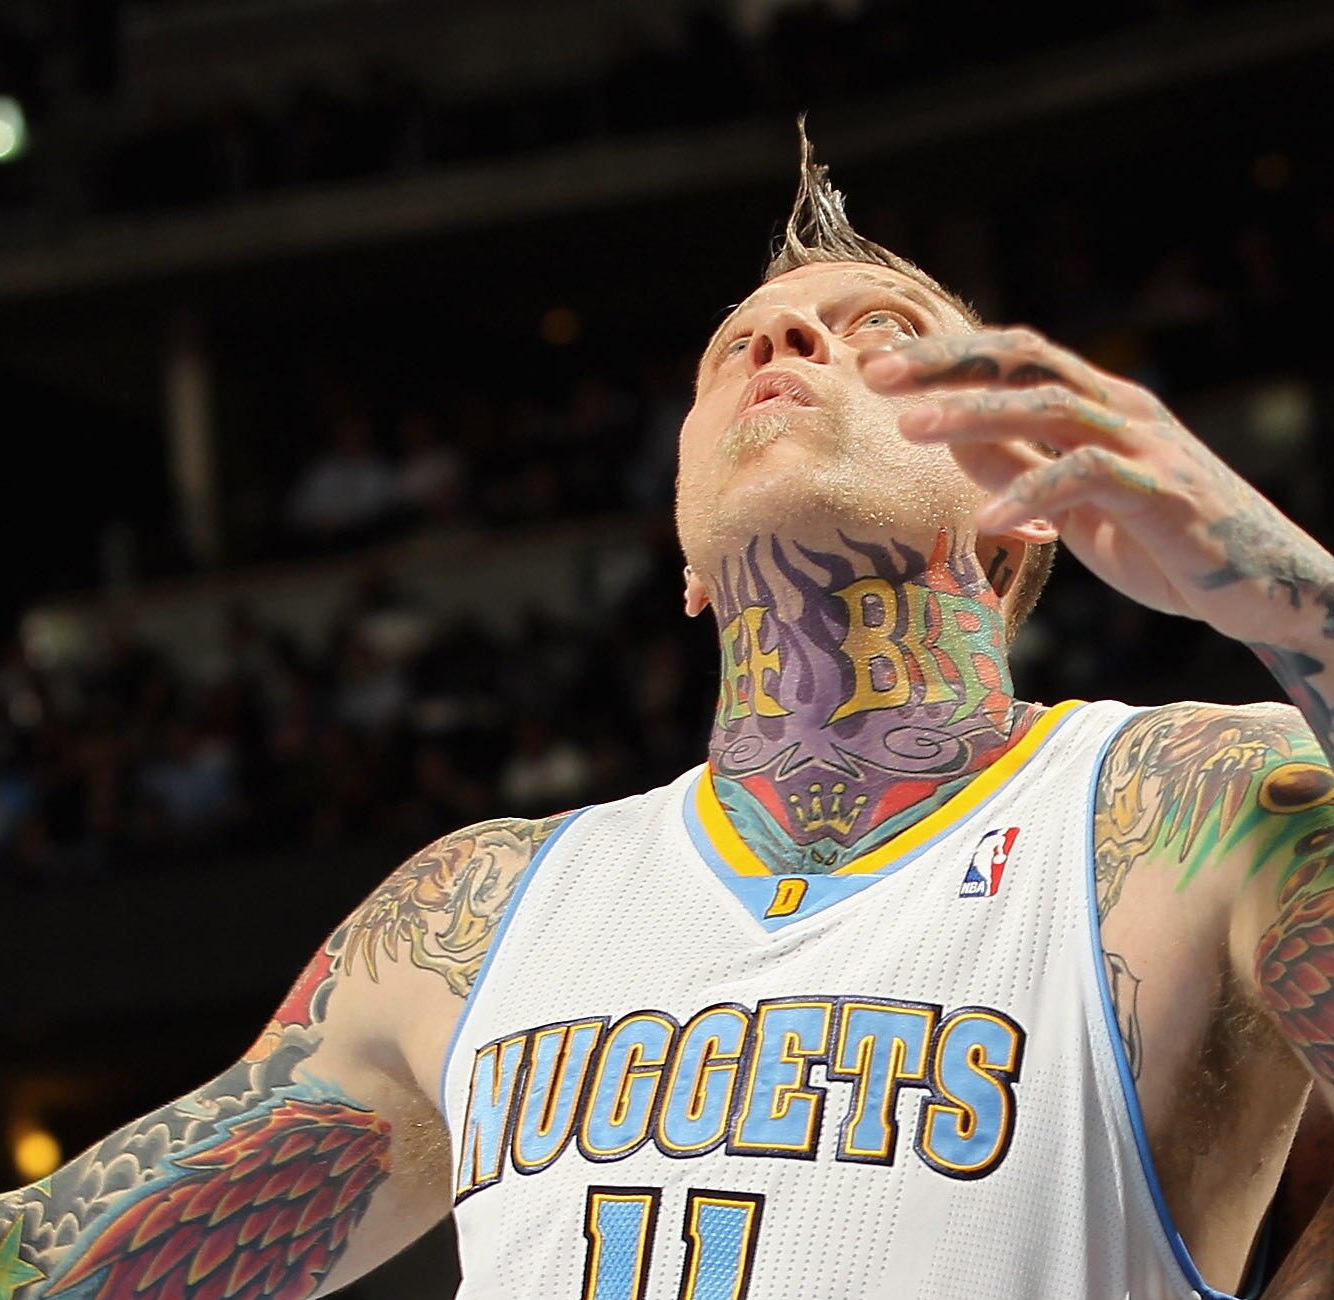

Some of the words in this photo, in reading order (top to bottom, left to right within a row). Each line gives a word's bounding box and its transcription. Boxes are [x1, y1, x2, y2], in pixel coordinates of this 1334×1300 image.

[821, 575, 1014, 728] BIR
[765, 877, 809, 919] D
[961, 882, 985, 894] NBA
[455, 994, 1027, 1203] NUGGETS
